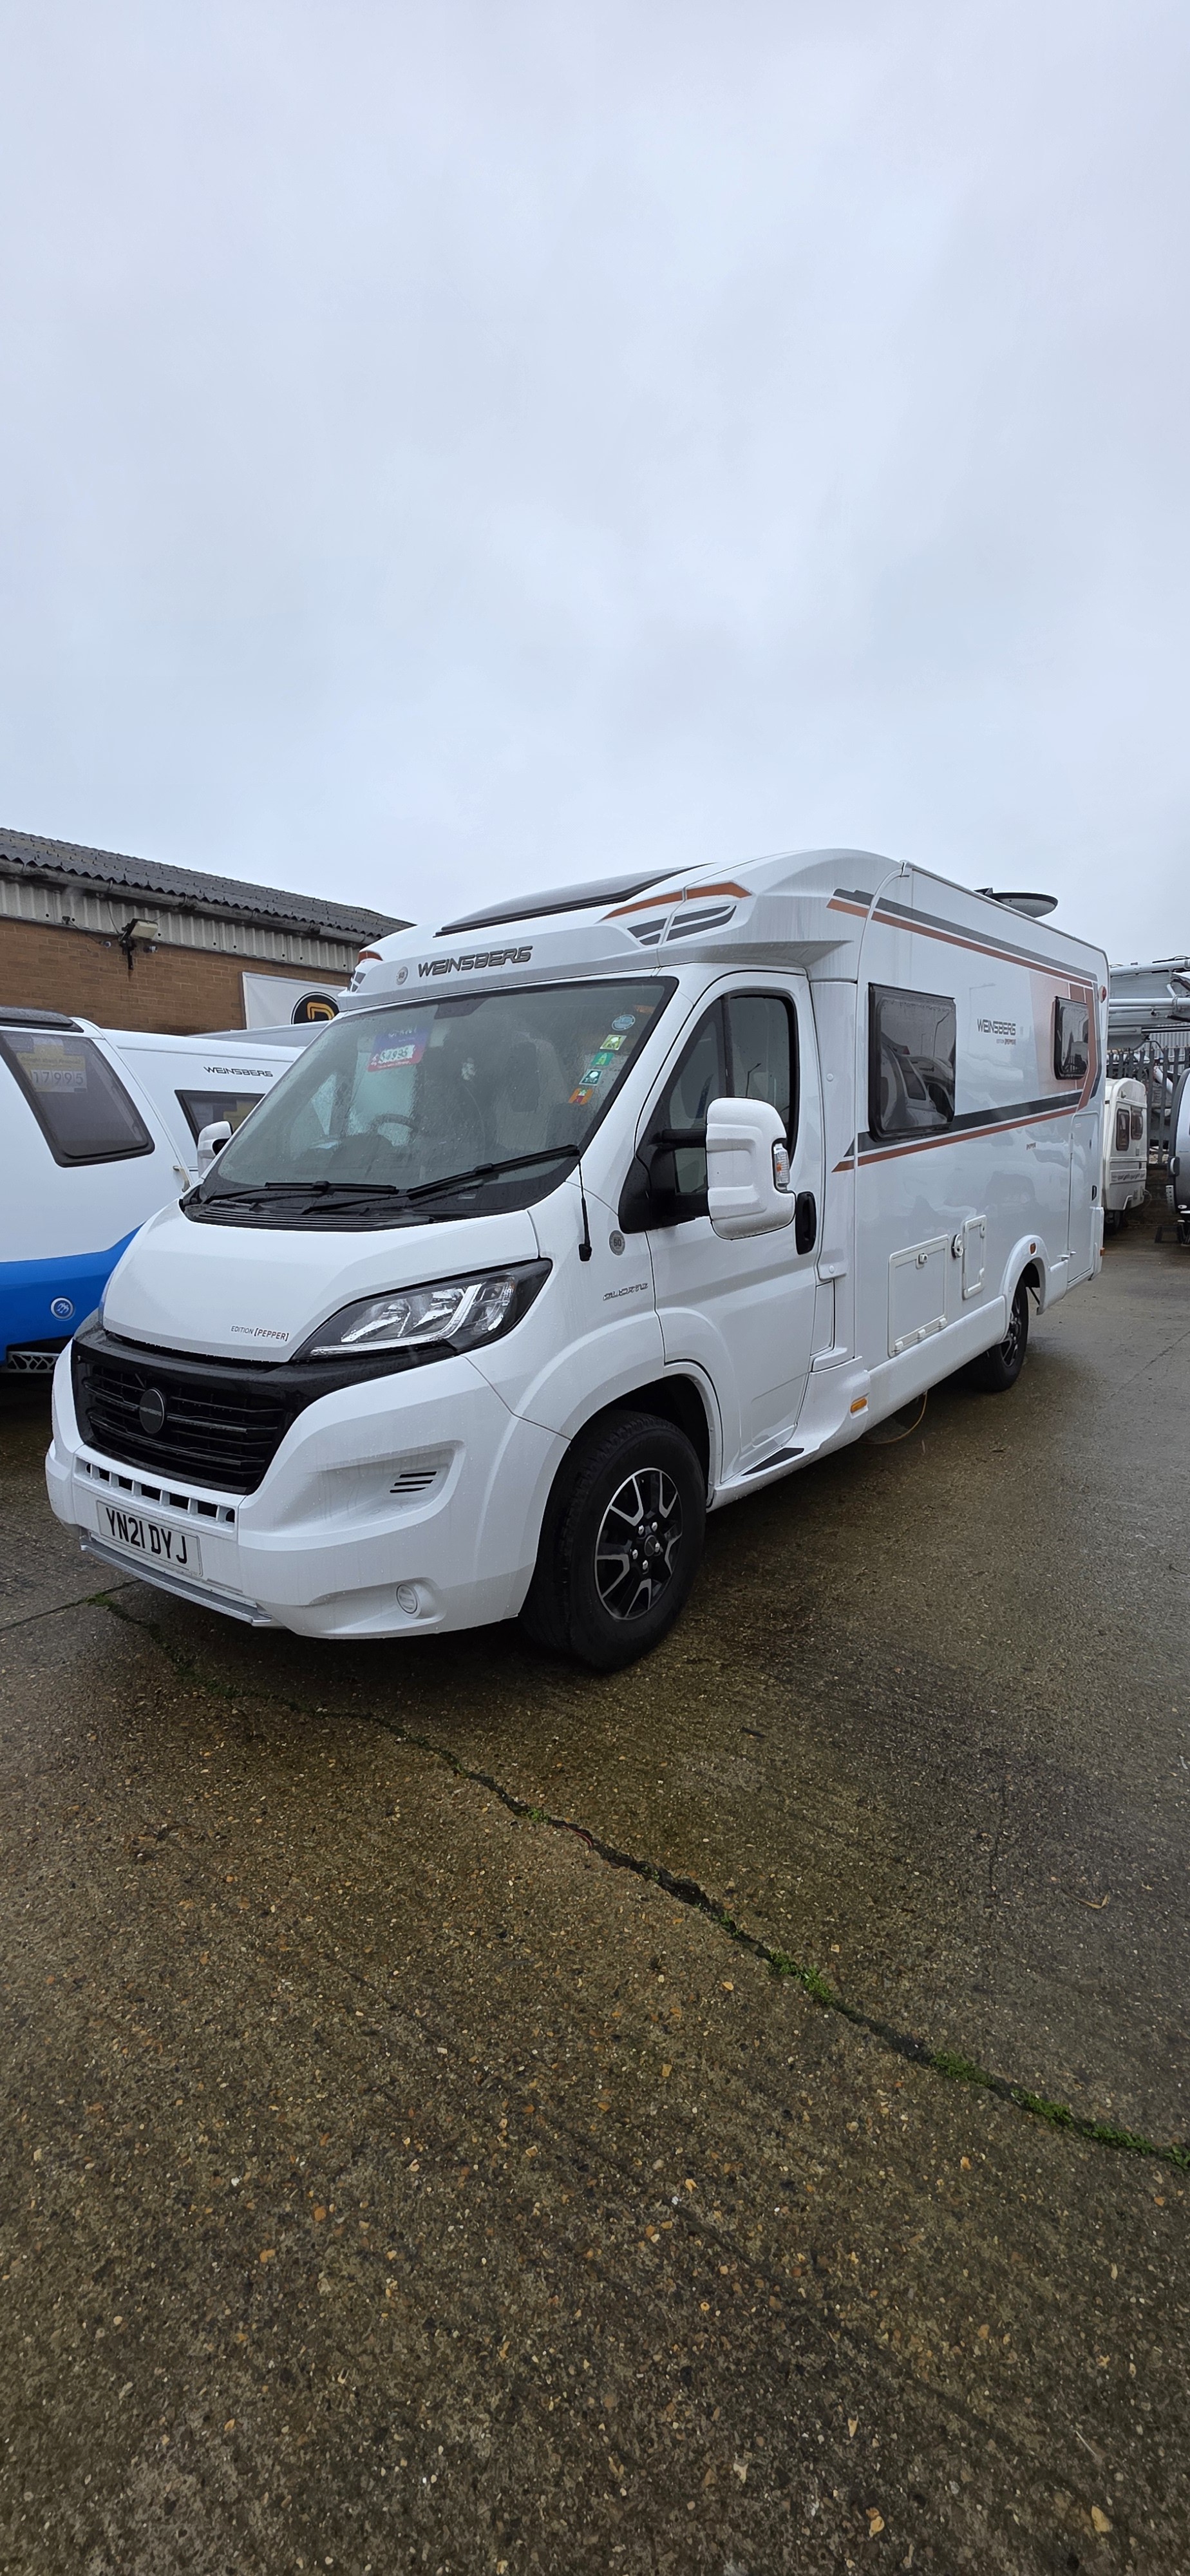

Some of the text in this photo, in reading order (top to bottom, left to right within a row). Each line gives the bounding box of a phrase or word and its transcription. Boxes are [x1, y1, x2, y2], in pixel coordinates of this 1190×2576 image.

[418, 945, 533, 978] WEINSBERG
[977, 1019, 1016, 1036] WEINSBERG
[33, 1072, 84, 1084] 17995
[203, 1066, 273, 1077] WEINSBERG
[231, 1326, 290, 1341] EDITION [PEPPER]
[106, 1508, 187, 1564] YN21 DYJ
